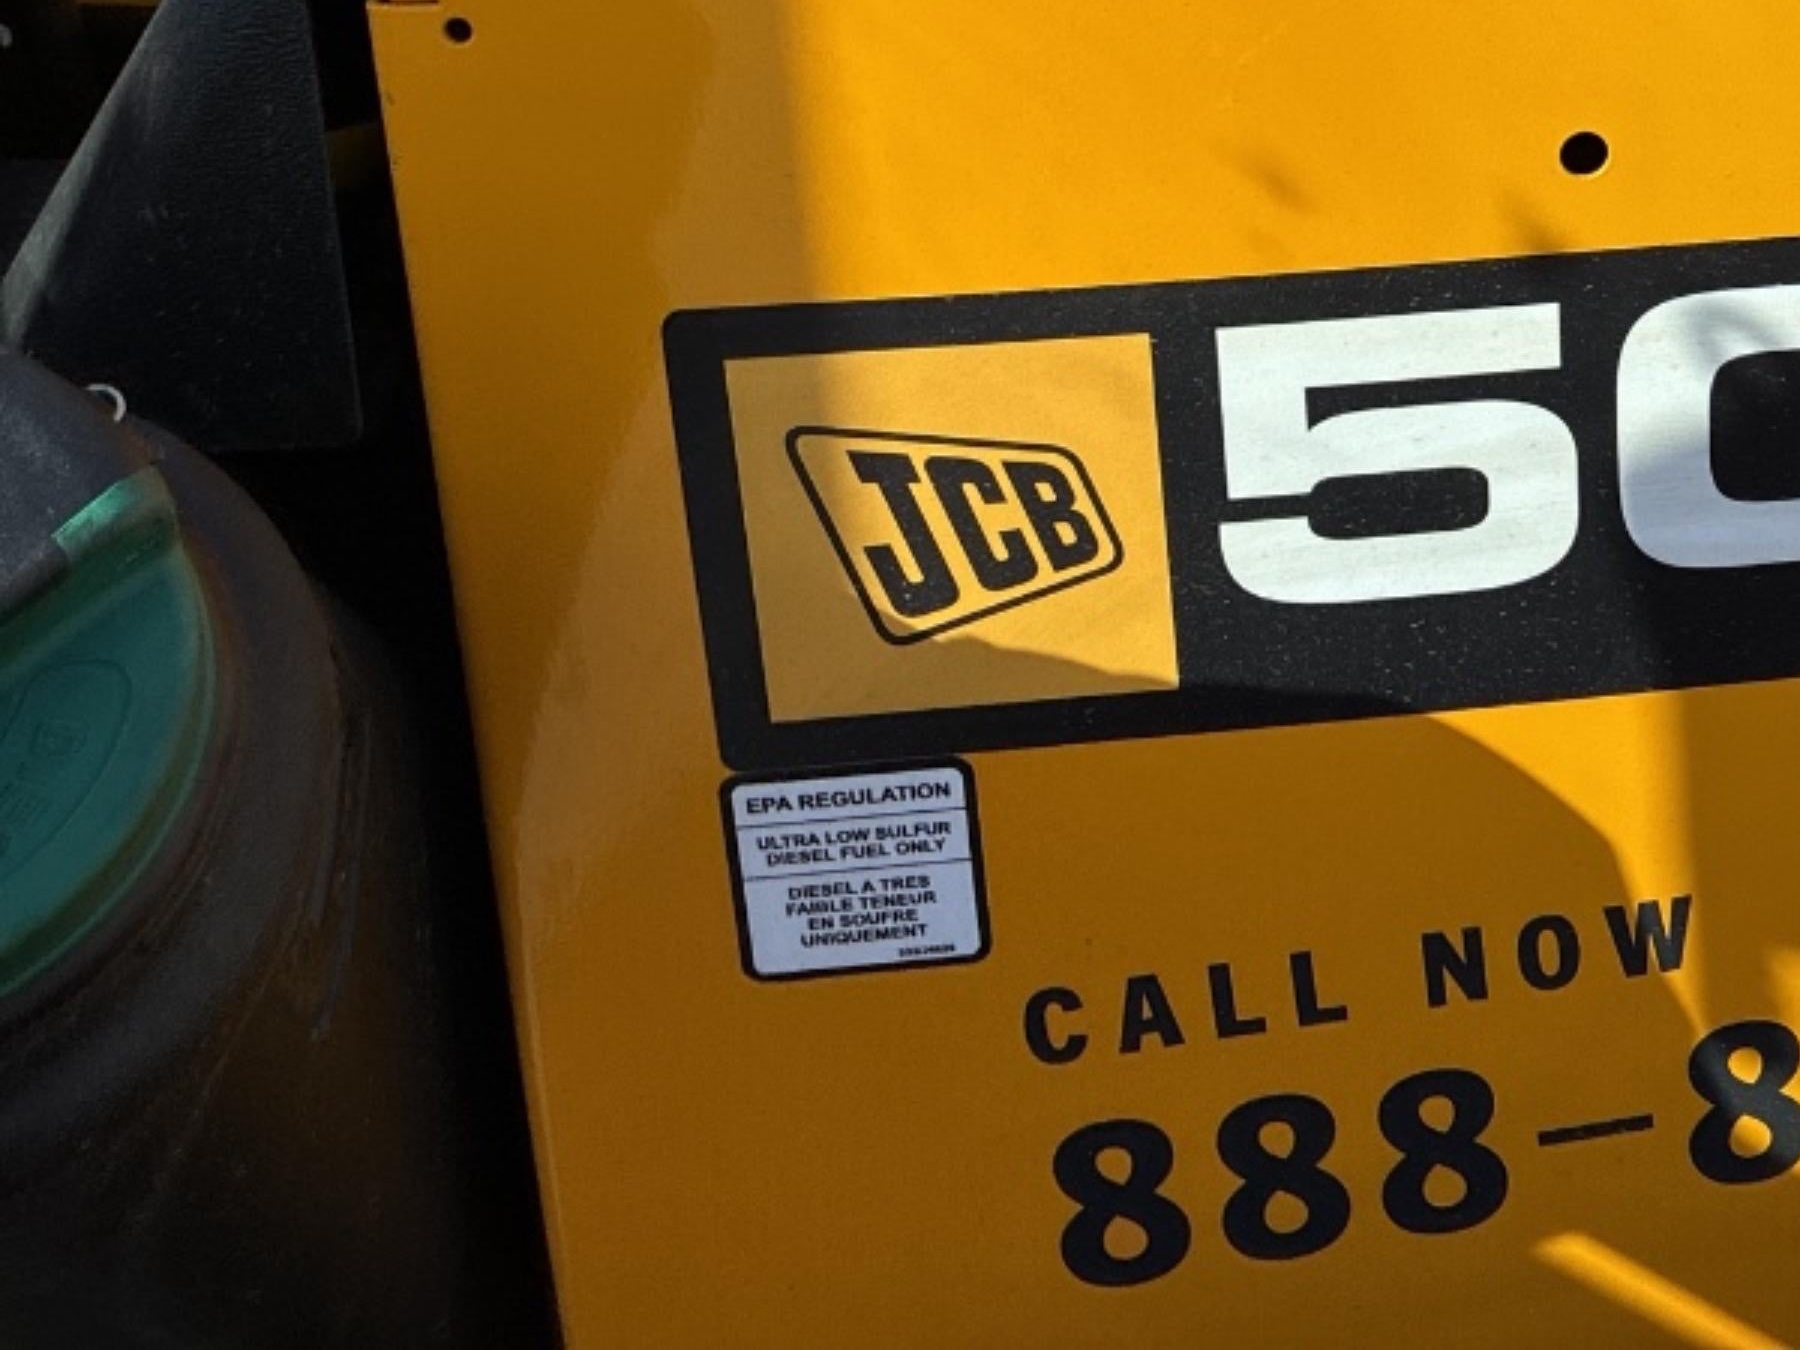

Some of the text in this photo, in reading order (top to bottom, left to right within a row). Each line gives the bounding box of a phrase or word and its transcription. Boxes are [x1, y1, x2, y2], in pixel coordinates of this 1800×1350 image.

[850, 450, 1100, 617] JCB
[746, 782, 951, 814] EPA REGULATION
[756, 821, 952, 851] ULTRA LOW SULFUR
[767, 837, 946, 867] DIESEL FUEL ONLY
[788, 875, 931, 900] DIESEL A TRES
[785, 890, 937, 917] FAIBLE TENEUR
[807, 908, 919, 931] EN SOUFRE
[800, 923, 928, 948] UNIQUEMENT
[1023, 894, 1693, 1066] CALL NOW
